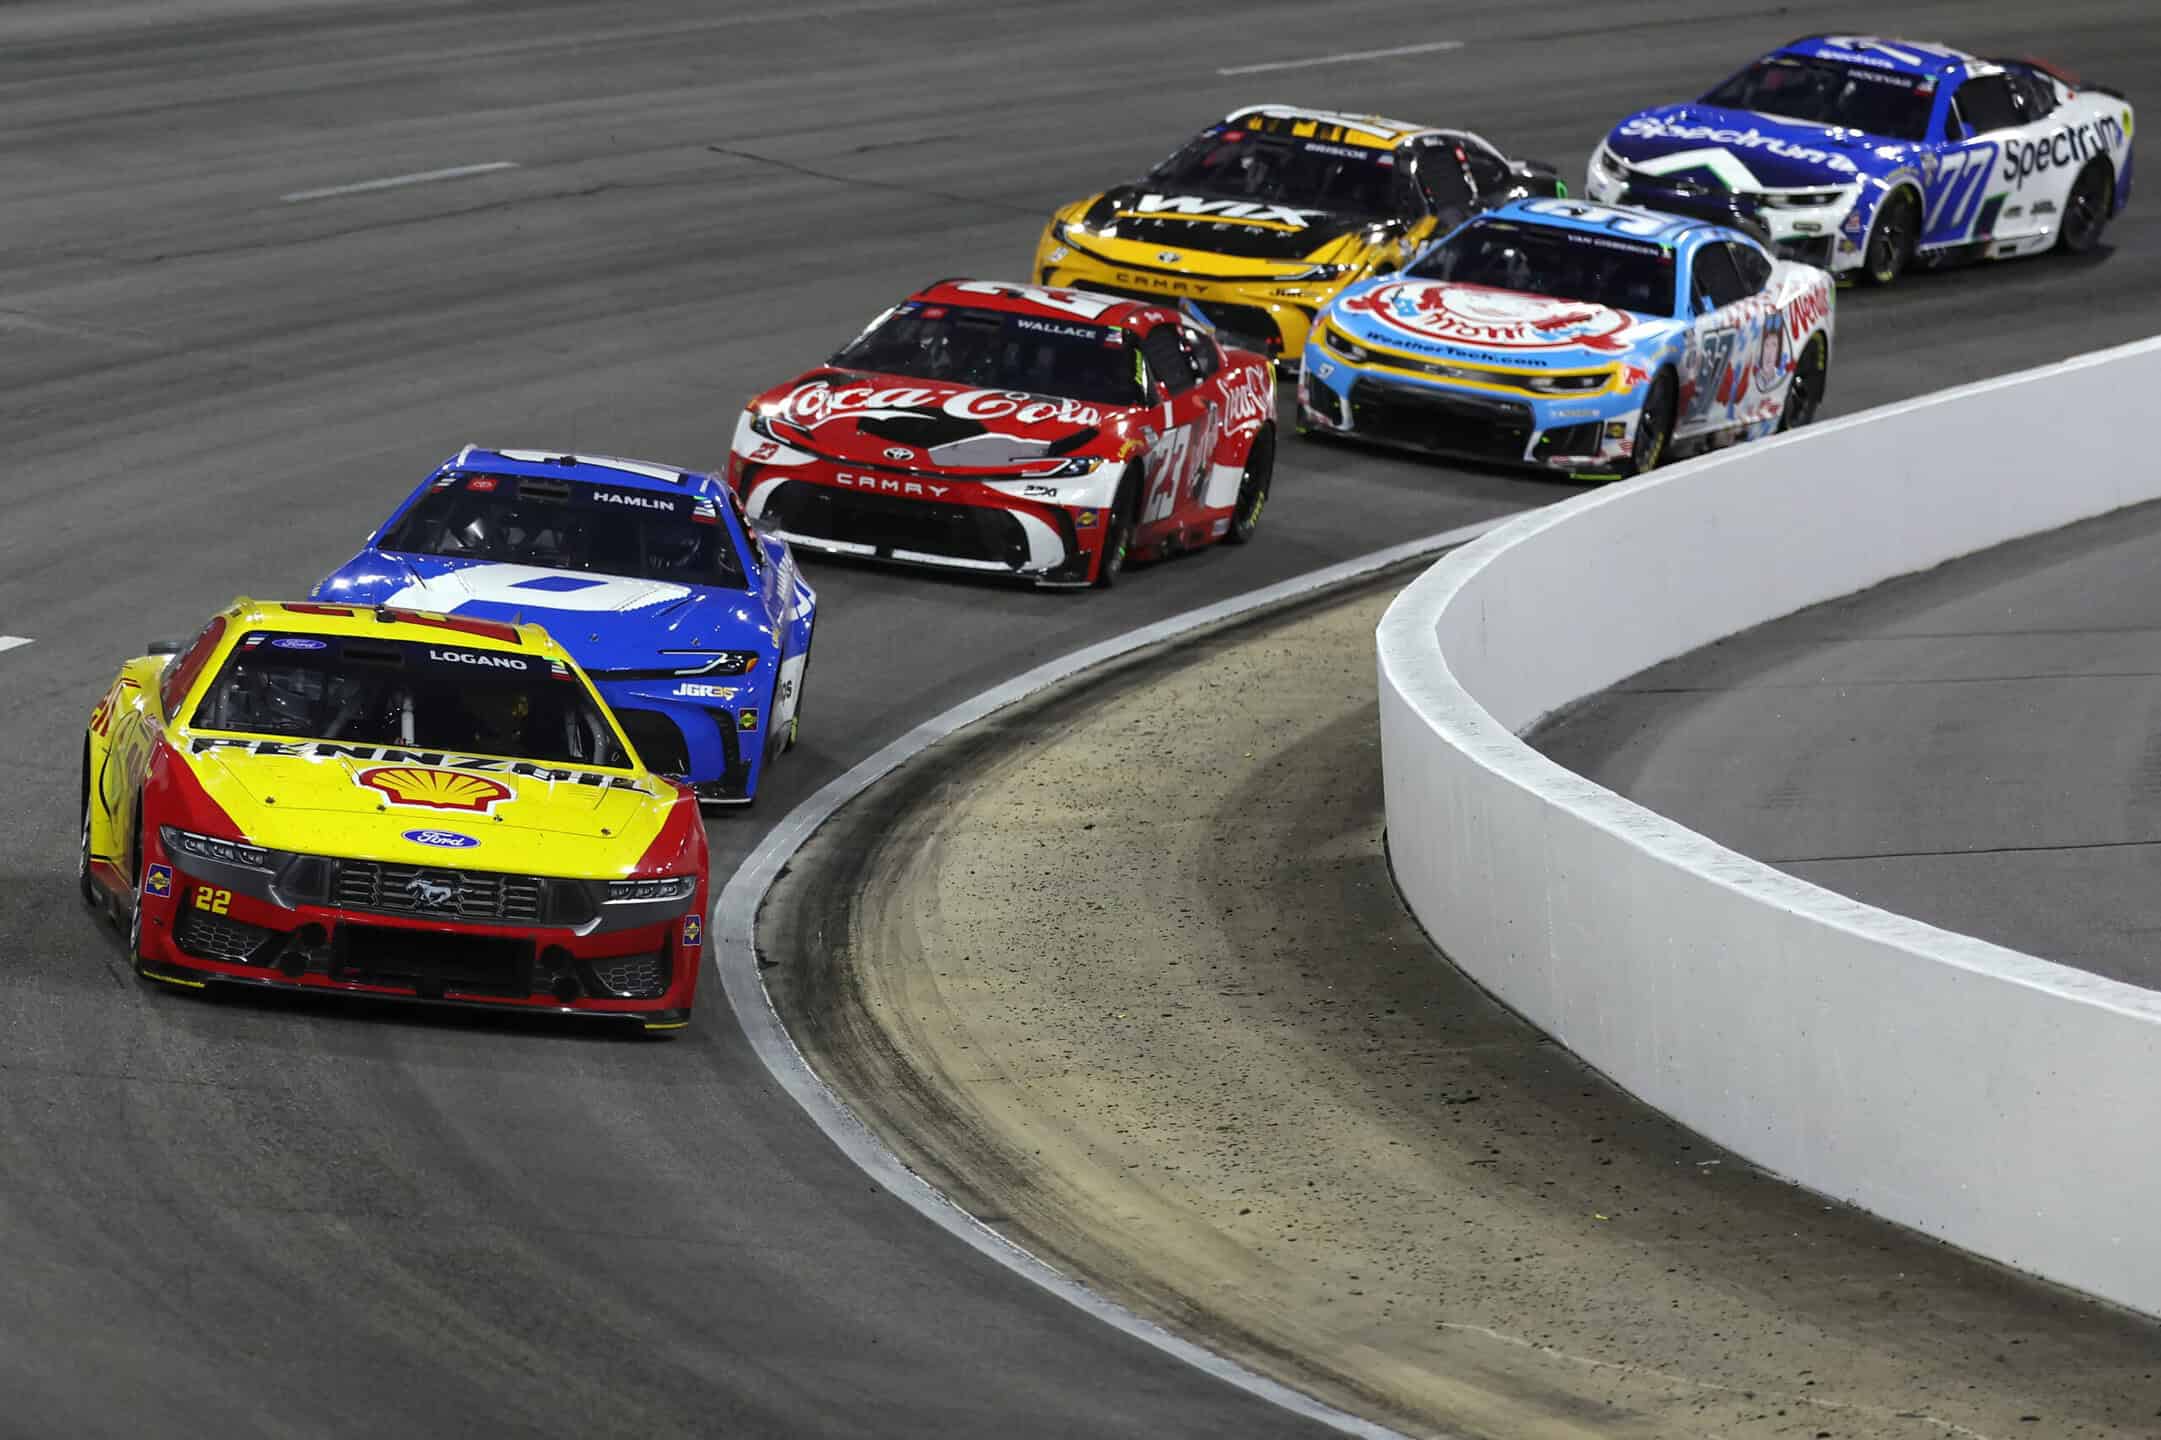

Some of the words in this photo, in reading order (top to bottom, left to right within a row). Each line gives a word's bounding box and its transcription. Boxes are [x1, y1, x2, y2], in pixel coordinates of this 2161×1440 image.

[1620, 117, 1858, 175] Spectrum
[2003, 116, 2124, 191] Spectrum
[1925, 146, 1994, 233] 77
[1136, 194, 1330, 228] WIX
[1115, 272, 1210, 294] CAMRY
[1017, 319, 1096, 340] WALLACE
[779, 377, 1112, 430] Coca-Cola
[749, 442, 781, 460] 23
[835, 472, 950, 498] CAMRY
[1141, 423, 1192, 523] 23
[593, 491, 675, 512] HAMLIN
[429, 649, 528, 672] LOGANO
[414, 829, 468, 848] Ford
[195, 886, 232, 915] 22
